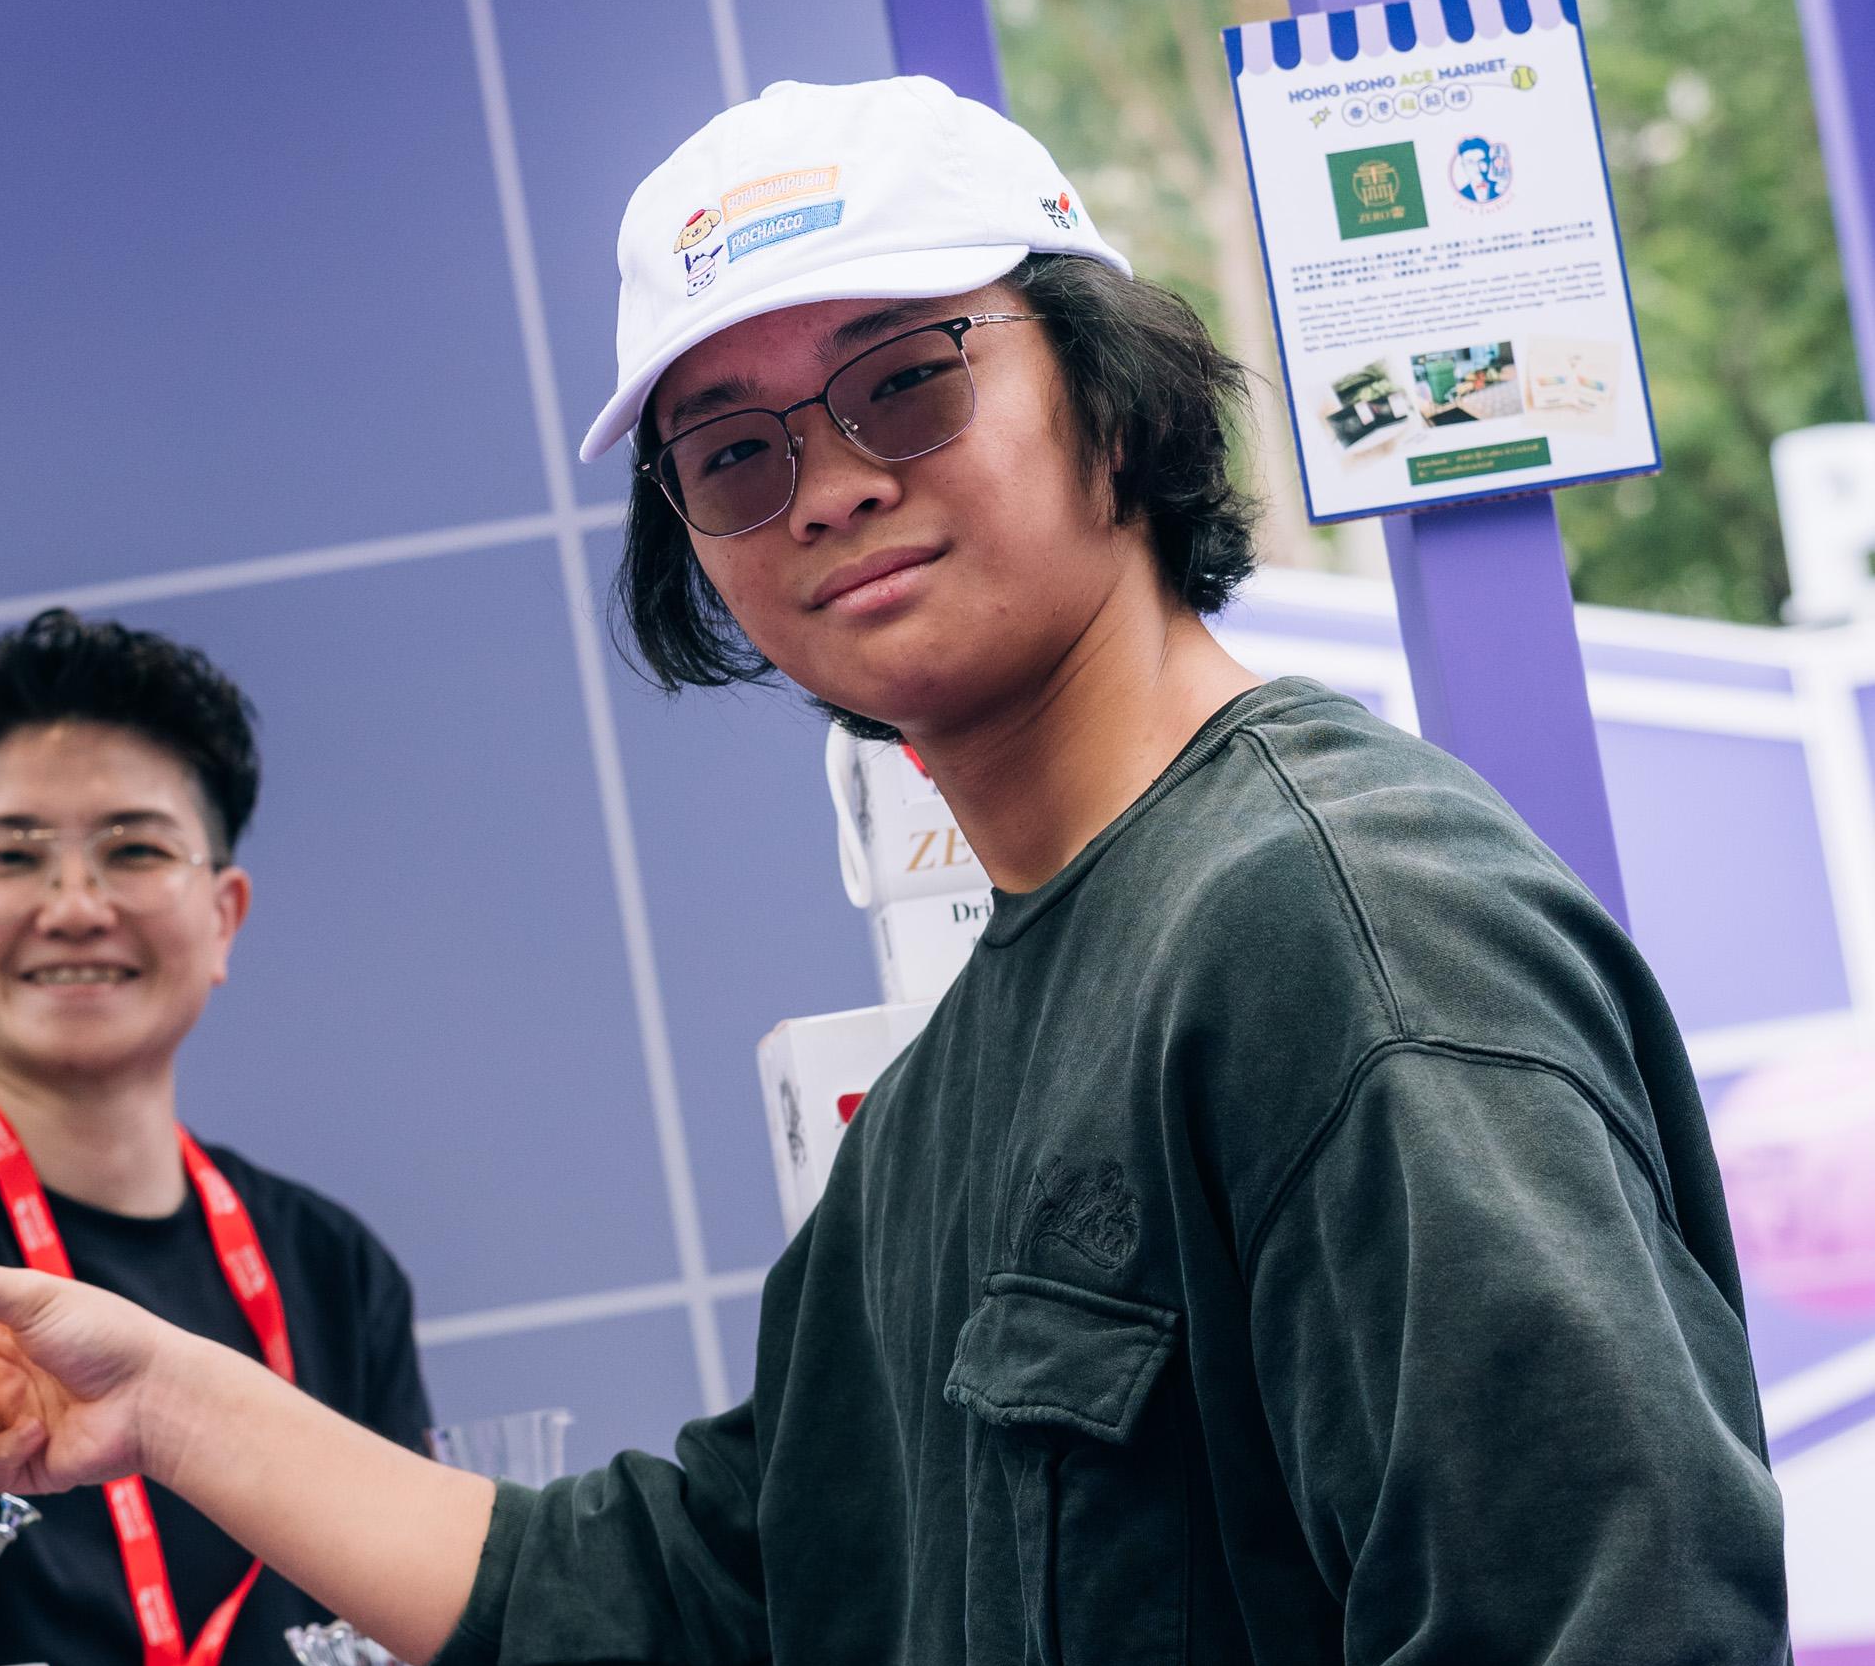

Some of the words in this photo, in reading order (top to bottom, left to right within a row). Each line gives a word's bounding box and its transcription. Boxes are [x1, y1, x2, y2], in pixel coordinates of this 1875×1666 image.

[1288, 84, 1341, 104] HONG
[1345, 75, 1397, 95] KONG
[1400, 69, 1434, 87] ACE
[1437, 58, 1507, 80] MARKET
[1038, 196, 1064, 215] HK
[731, 214, 805, 253] POCHACCO
